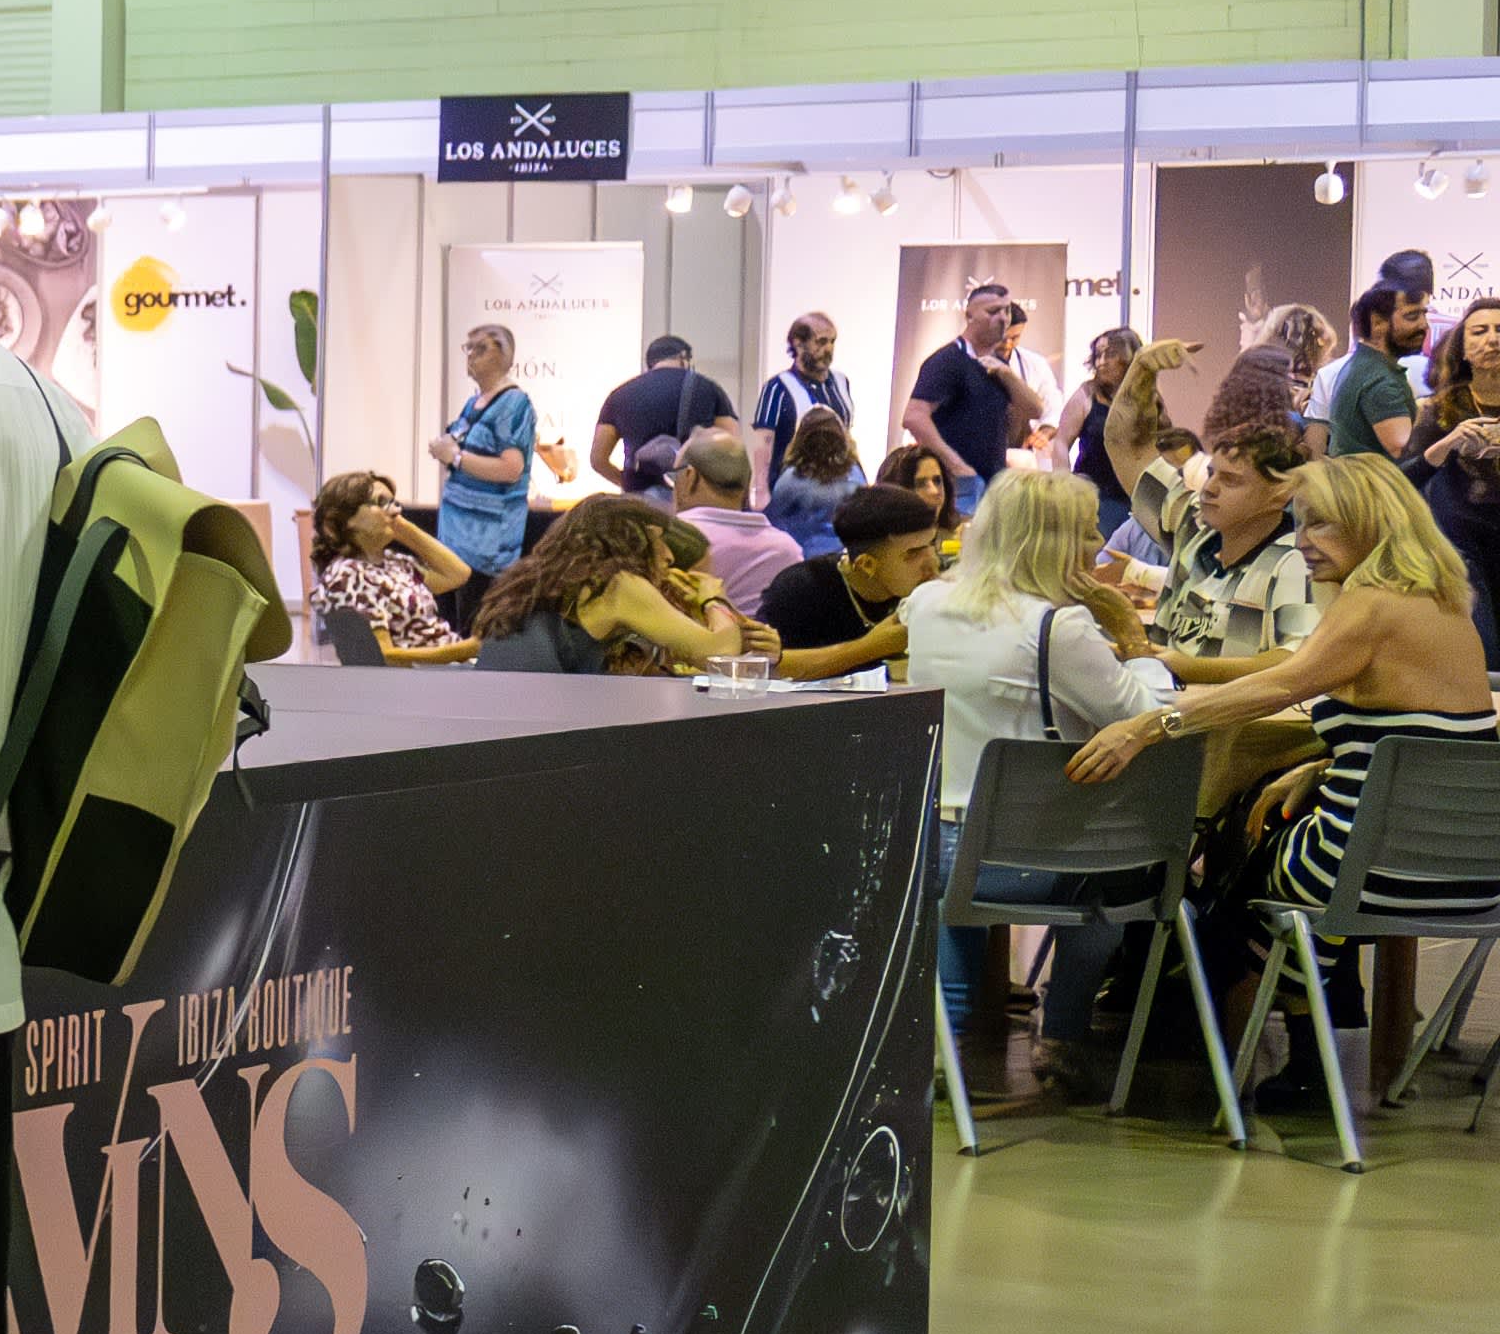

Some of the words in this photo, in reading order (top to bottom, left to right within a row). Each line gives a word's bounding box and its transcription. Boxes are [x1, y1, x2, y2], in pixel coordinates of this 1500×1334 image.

[445, 143, 484, 160] LOS
[491, 140, 621, 159] ANDALUCES
[24, 1009, 107, 1097] SPIRIT
[177, 990, 238, 1068] IBIZA
[247, 965, 354, 1047] BOUTIQUE
